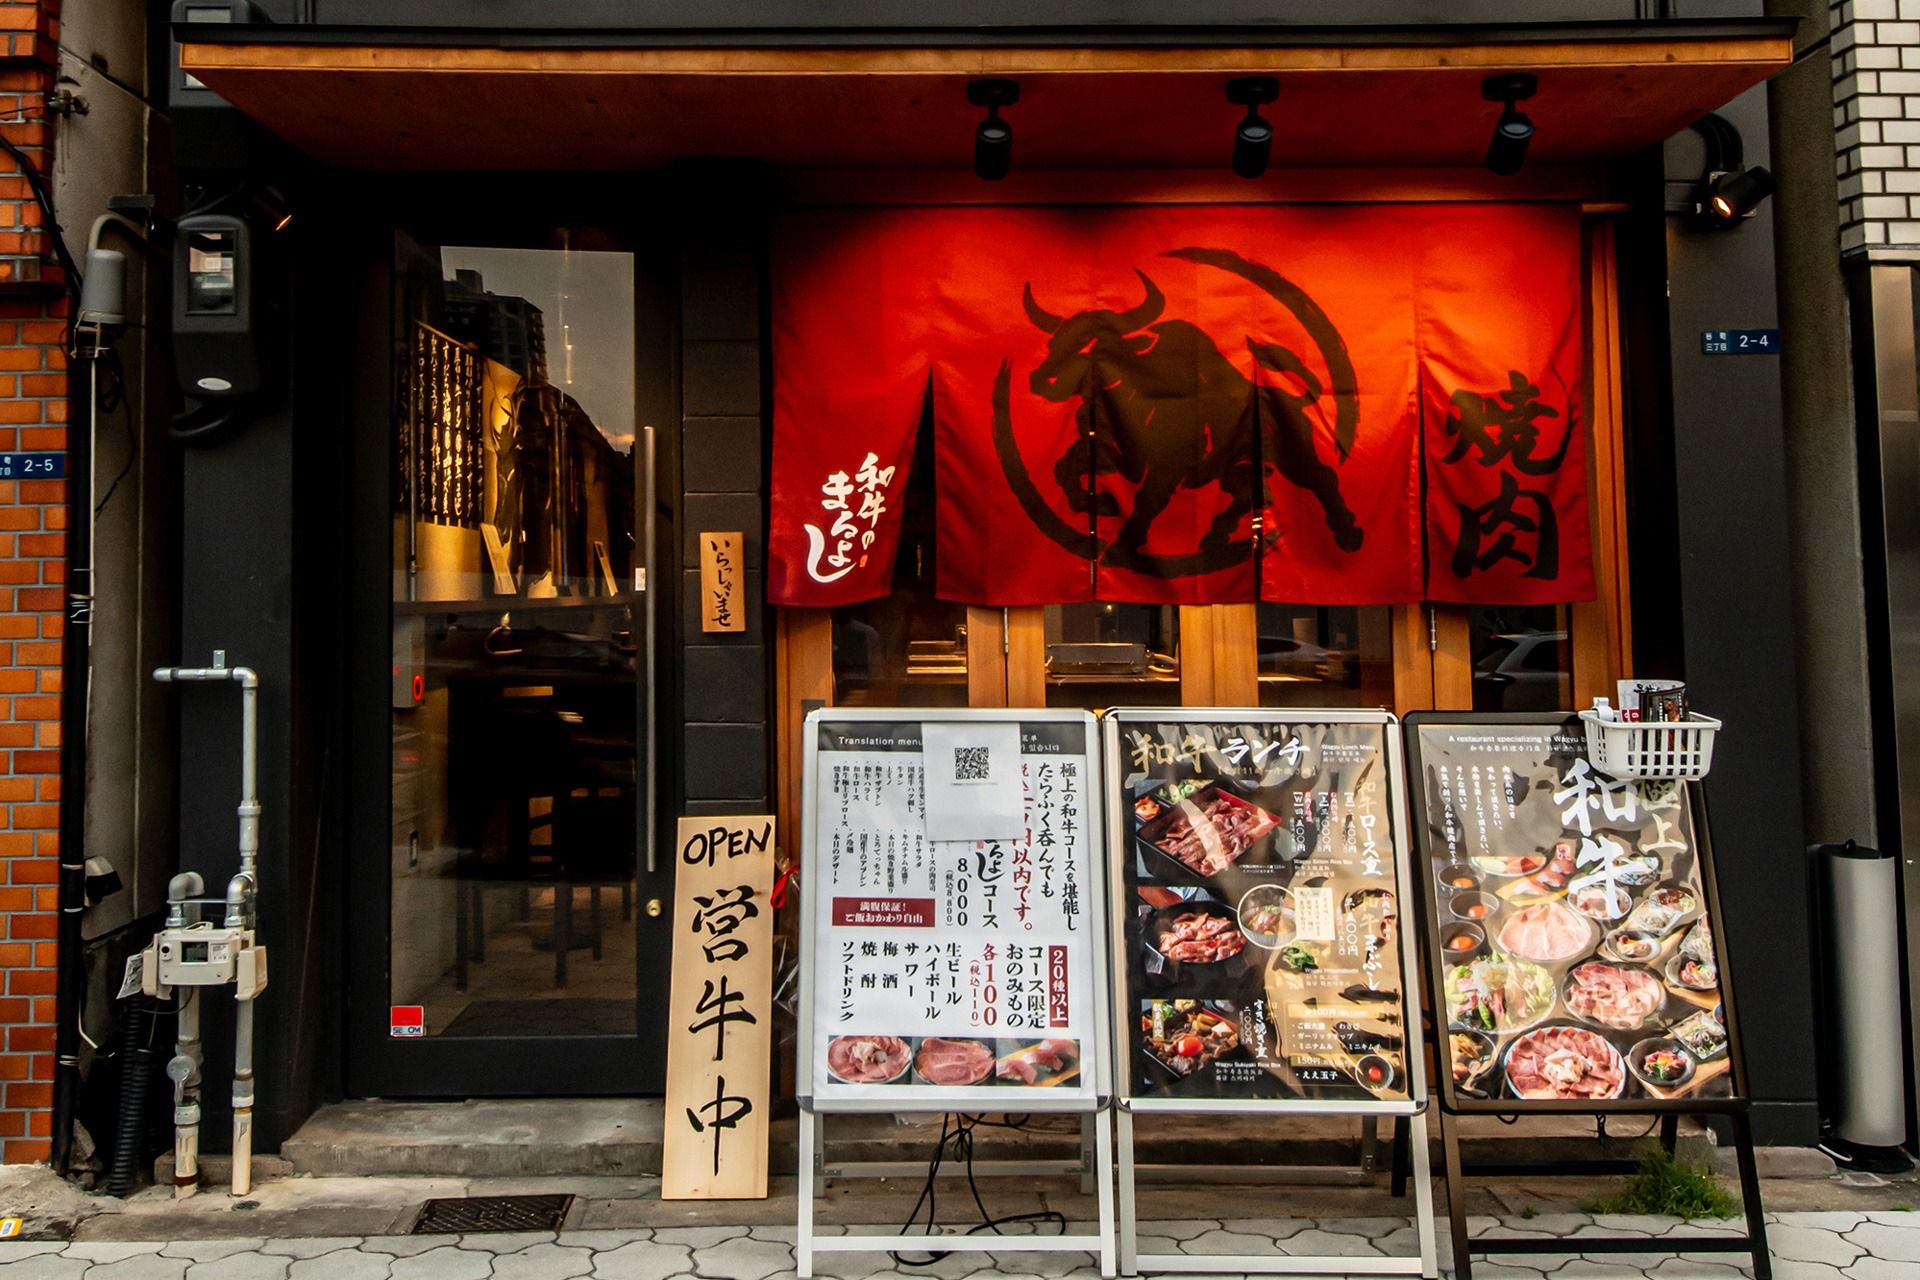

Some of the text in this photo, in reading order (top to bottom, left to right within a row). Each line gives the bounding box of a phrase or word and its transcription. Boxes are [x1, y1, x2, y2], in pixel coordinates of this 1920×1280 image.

[1739, 335, 1769, 348] 2-4
[24, 459, 54, 472] 2-5
[854, 452, 896, 550] 和牛の
[1440, 370, 1567, 581] 焼肉
[803, 470, 859, 583] まるよし
[710, 540, 733, 627] いらっしゃいませ
[839, 736, 894, 746] Translation
[1496, 735, 1542, 743] specializing
[1553, 735, 1579, 743] Wagyu
[683, 822, 771, 867] OPEN
[1036, 762, 1056, 898] たらふく呑んでも
[1059, 762, 1080, 931] 極上の和牛コースを堪能し
[1553, 758, 1651, 919] 和牛
[845, 913, 924, 924] ご飯おかわり自由
[840, 942, 855, 1022] ソフトドリンク
[904, 943, 920, 998] サワー
[924, 944, 941, 1020] ハイボール
[946, 942, 963, 1005] 生ビール
[983, 943, 999, 1026] 各100
[1006, 943, 1024, 1028] おのみもの
[1027, 944, 1046, 1029] コース限定
[1051, 949, 1068, 1022] 20種以上
[685, 884, 759, 1177] 営牛中
